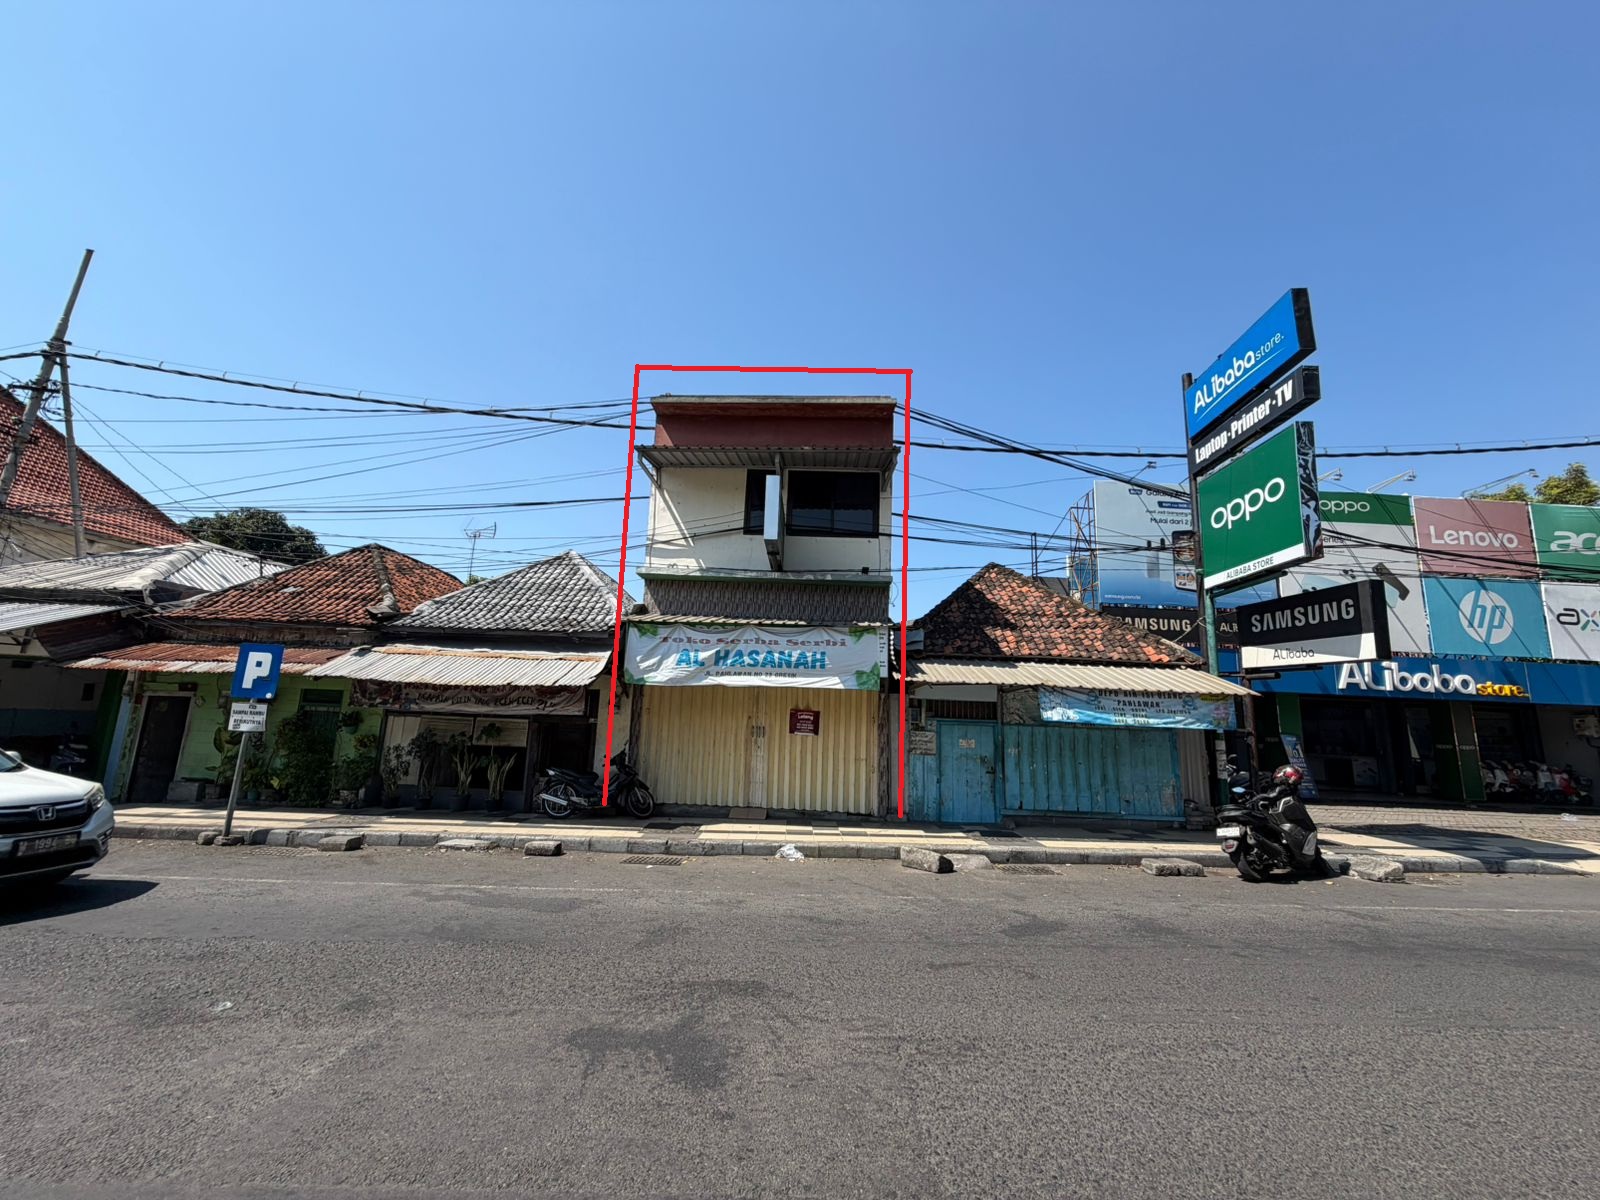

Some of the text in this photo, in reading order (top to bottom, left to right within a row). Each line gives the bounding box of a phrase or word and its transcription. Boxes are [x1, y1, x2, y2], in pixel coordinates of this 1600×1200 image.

[1195, 379, 1293, 464] Laptop Printer TV
[1210, 477, 1285, 530] oppo
[1319, 500, 1370, 514] oppo
[1429, 525, 1519, 549] Lenovo
[1550, 531, 1600, 555] ac
[1226, 556, 1274, 580] ALIBABA STORE
[1251, 598, 1355, 633] SAMSUNG
[1467, 590, 1507, 645] hp
[659, 635, 849, 648] Toko Serba Serbi
[241, 651, 273, 689] P
[675, 648, 828, 671] AL HASANAH
